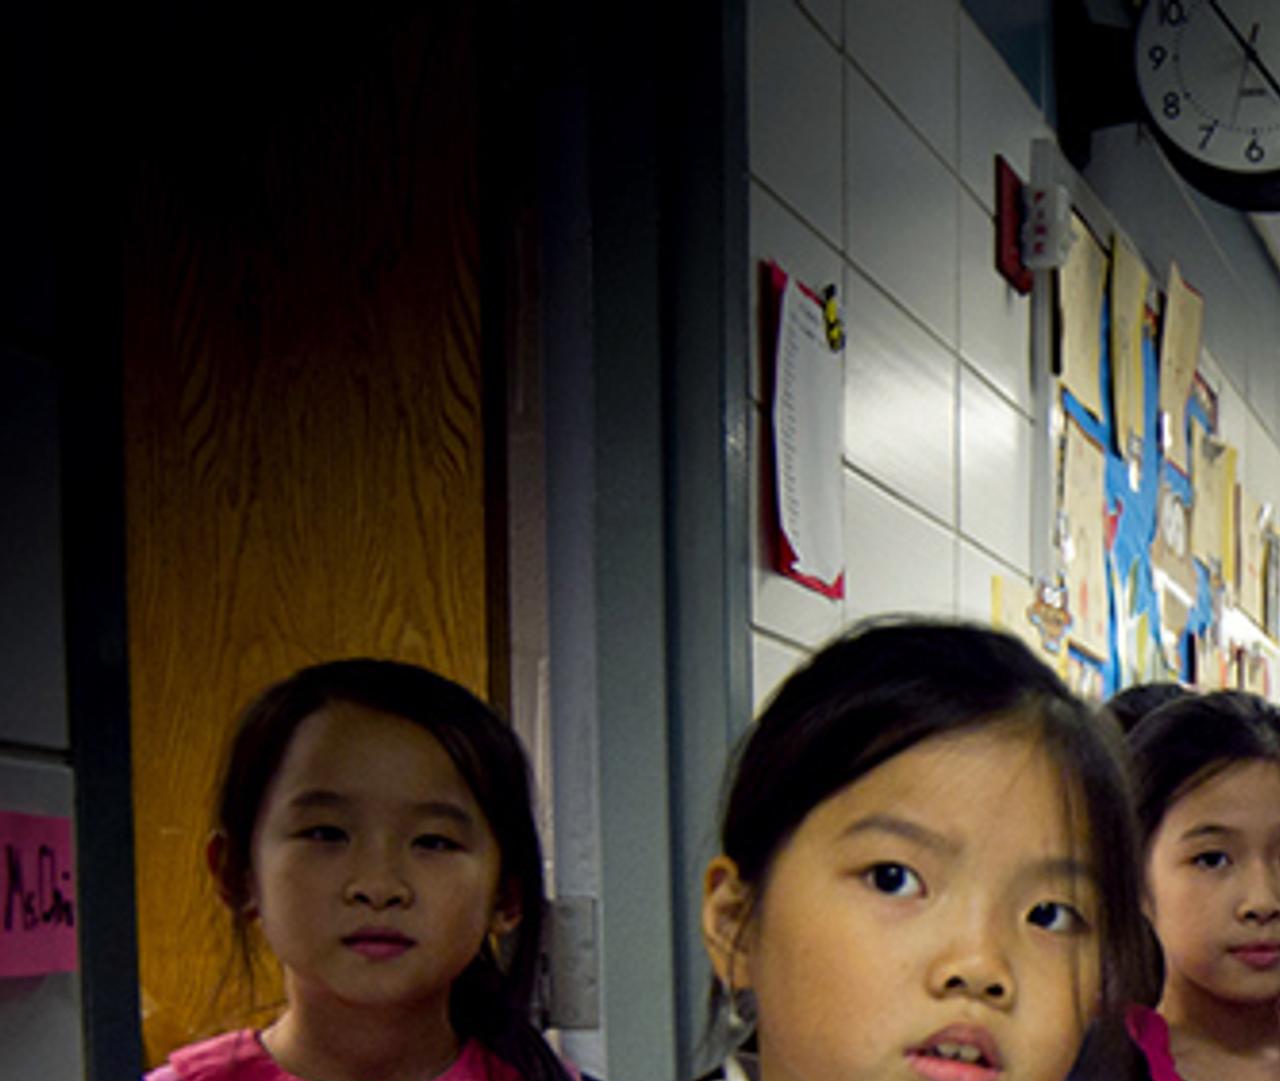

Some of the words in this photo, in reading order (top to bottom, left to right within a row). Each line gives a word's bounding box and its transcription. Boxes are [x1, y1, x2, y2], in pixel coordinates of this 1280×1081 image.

[1149, 44, 1167, 71] 9
[1162, 92, 1181, 120] 8
[1199, 125, 1215, 150] 7
[1244, 139, 1265, 164] 6
